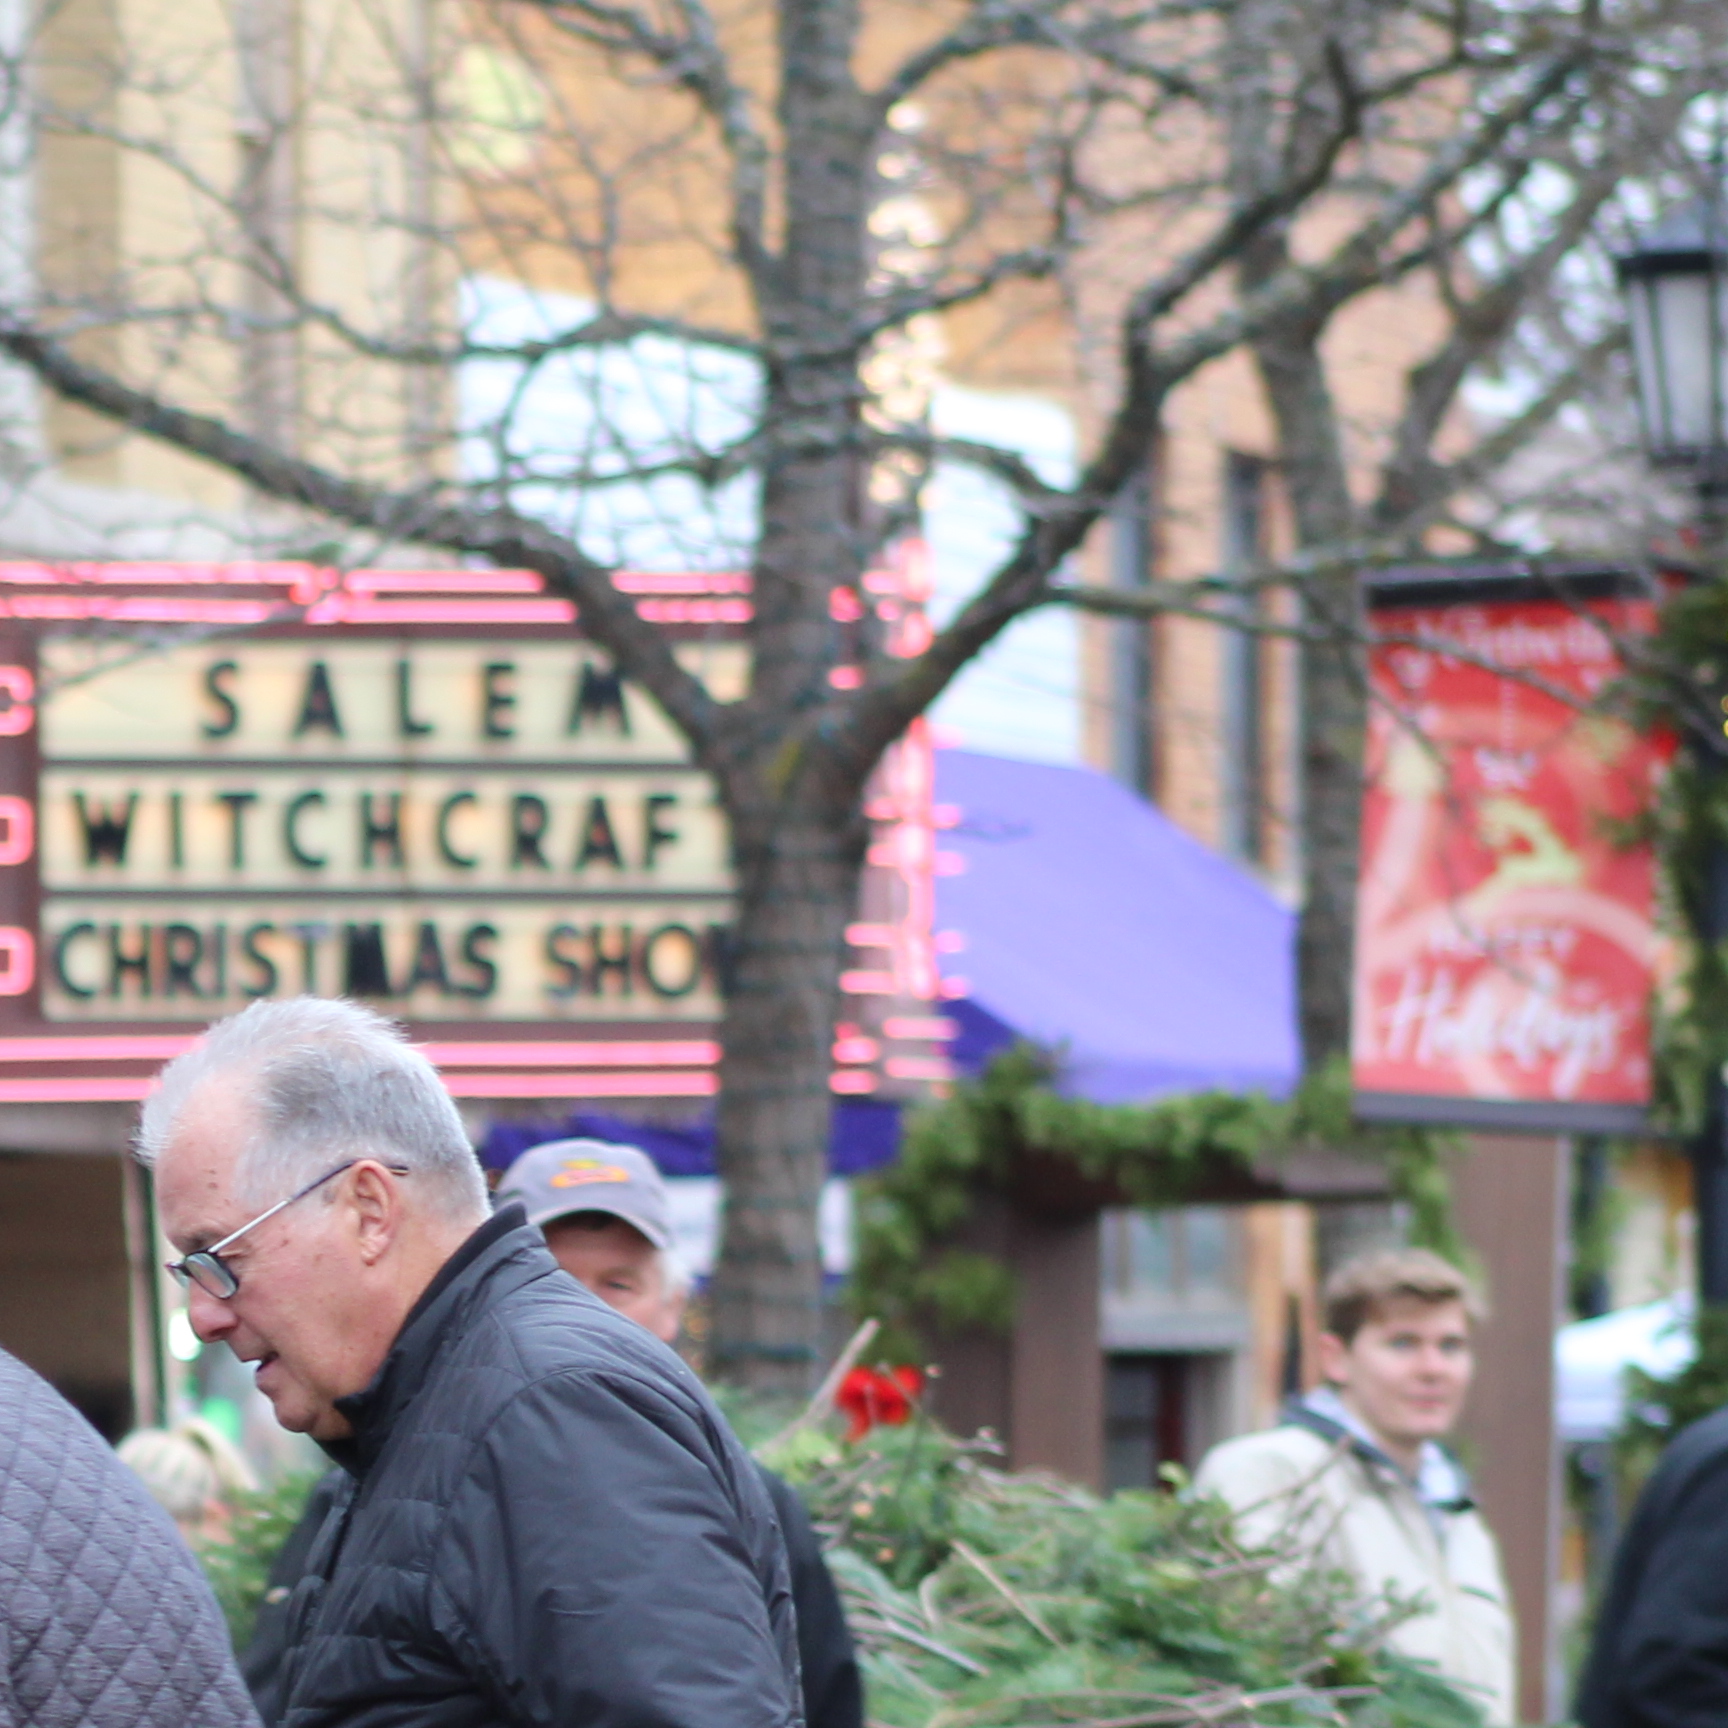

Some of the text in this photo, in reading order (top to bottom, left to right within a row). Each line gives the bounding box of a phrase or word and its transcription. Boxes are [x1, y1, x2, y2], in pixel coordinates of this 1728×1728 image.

[199, 659, 634, 741] SALEM
[69, 790, 732, 871] WITCHCRAF
[54, 922, 502, 1000] CHRISTMAS
